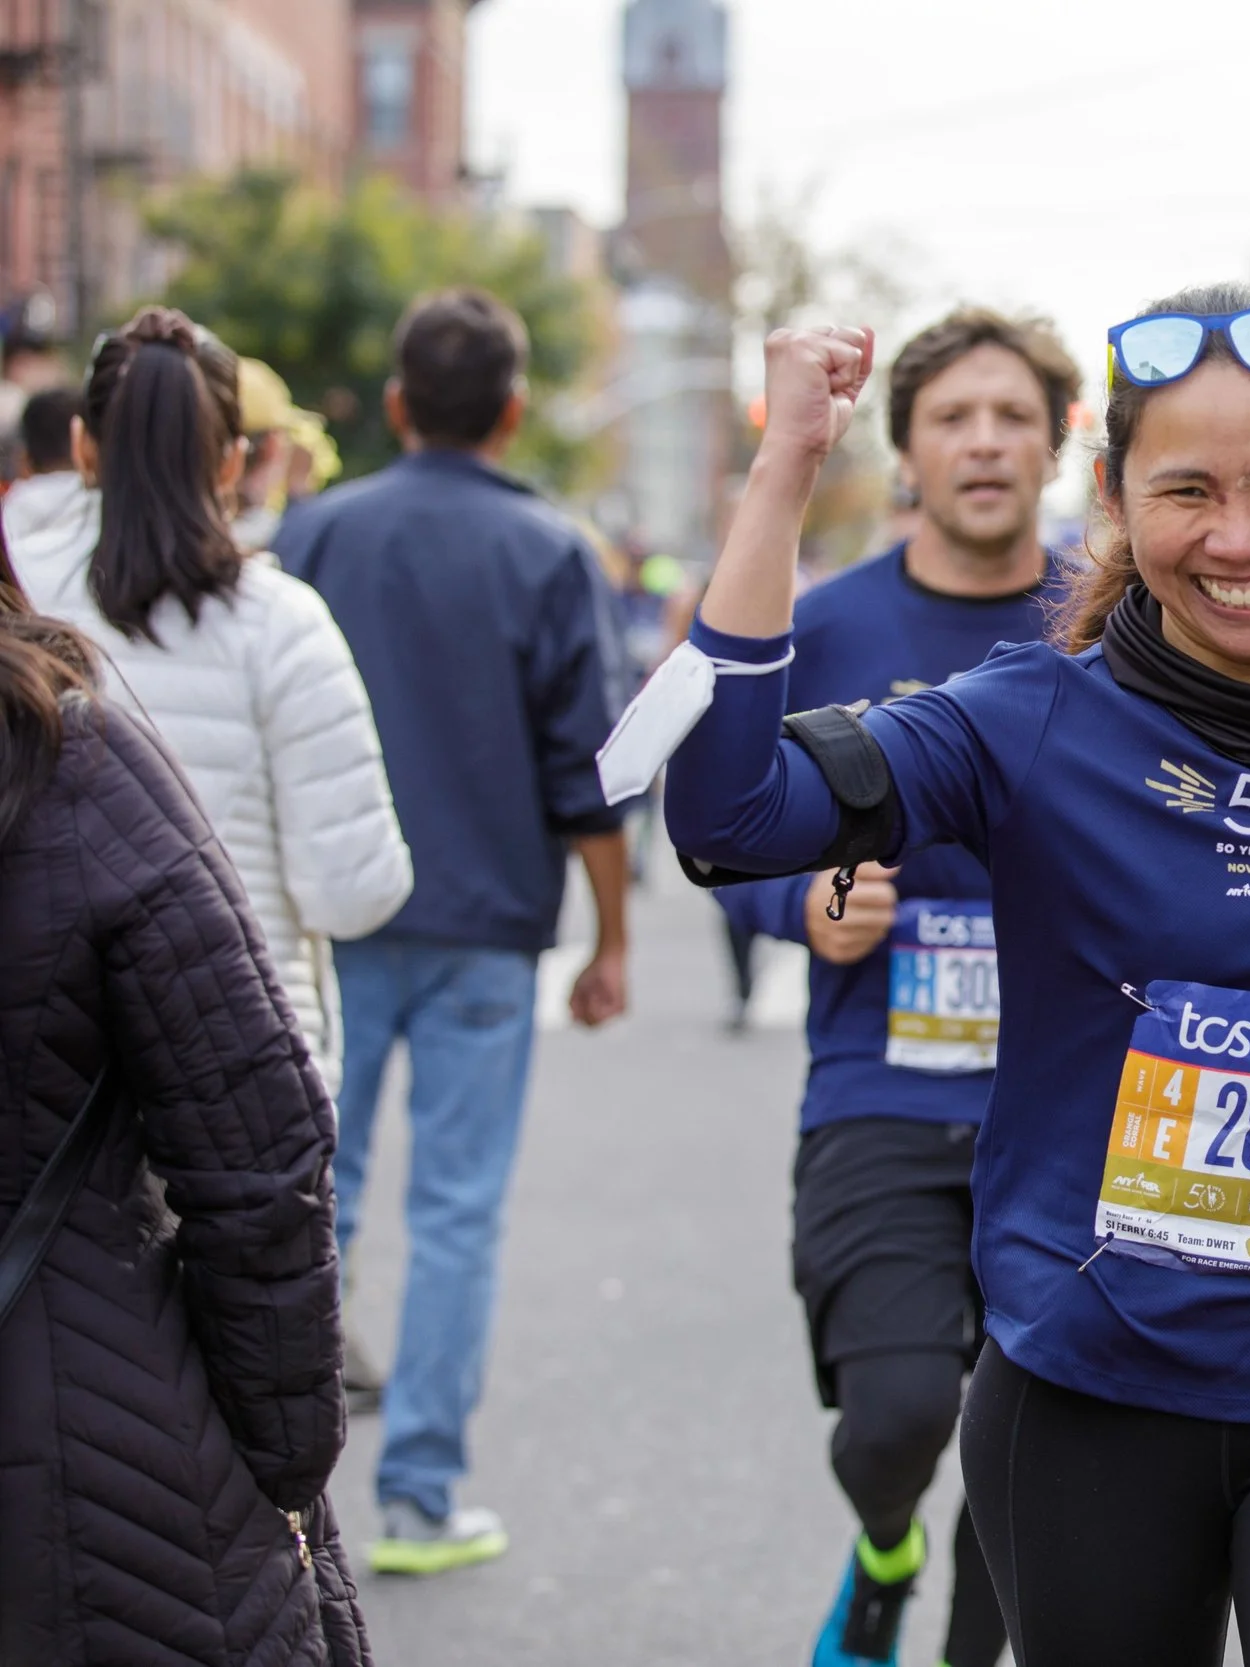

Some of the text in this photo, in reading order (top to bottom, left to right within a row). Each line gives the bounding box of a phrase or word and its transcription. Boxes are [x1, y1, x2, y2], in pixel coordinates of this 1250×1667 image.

[1216, 842, 1234, 854] 50
[1136, 1069, 1146, 1093] WAVE
[1163, 1069, 1184, 1106] 4
[1122, 1112, 1135, 1148] ORANGE
[1129, 1115, 1142, 1148] CORRAL
[1153, 1117, 1177, 1160] E
[1105, 1220, 1236, 1251] SI FERRY 6:45 Team: DWRT
[1181, 1255, 1197, 1263] FOR
[1197, 1258, 1218, 1267] RACE
